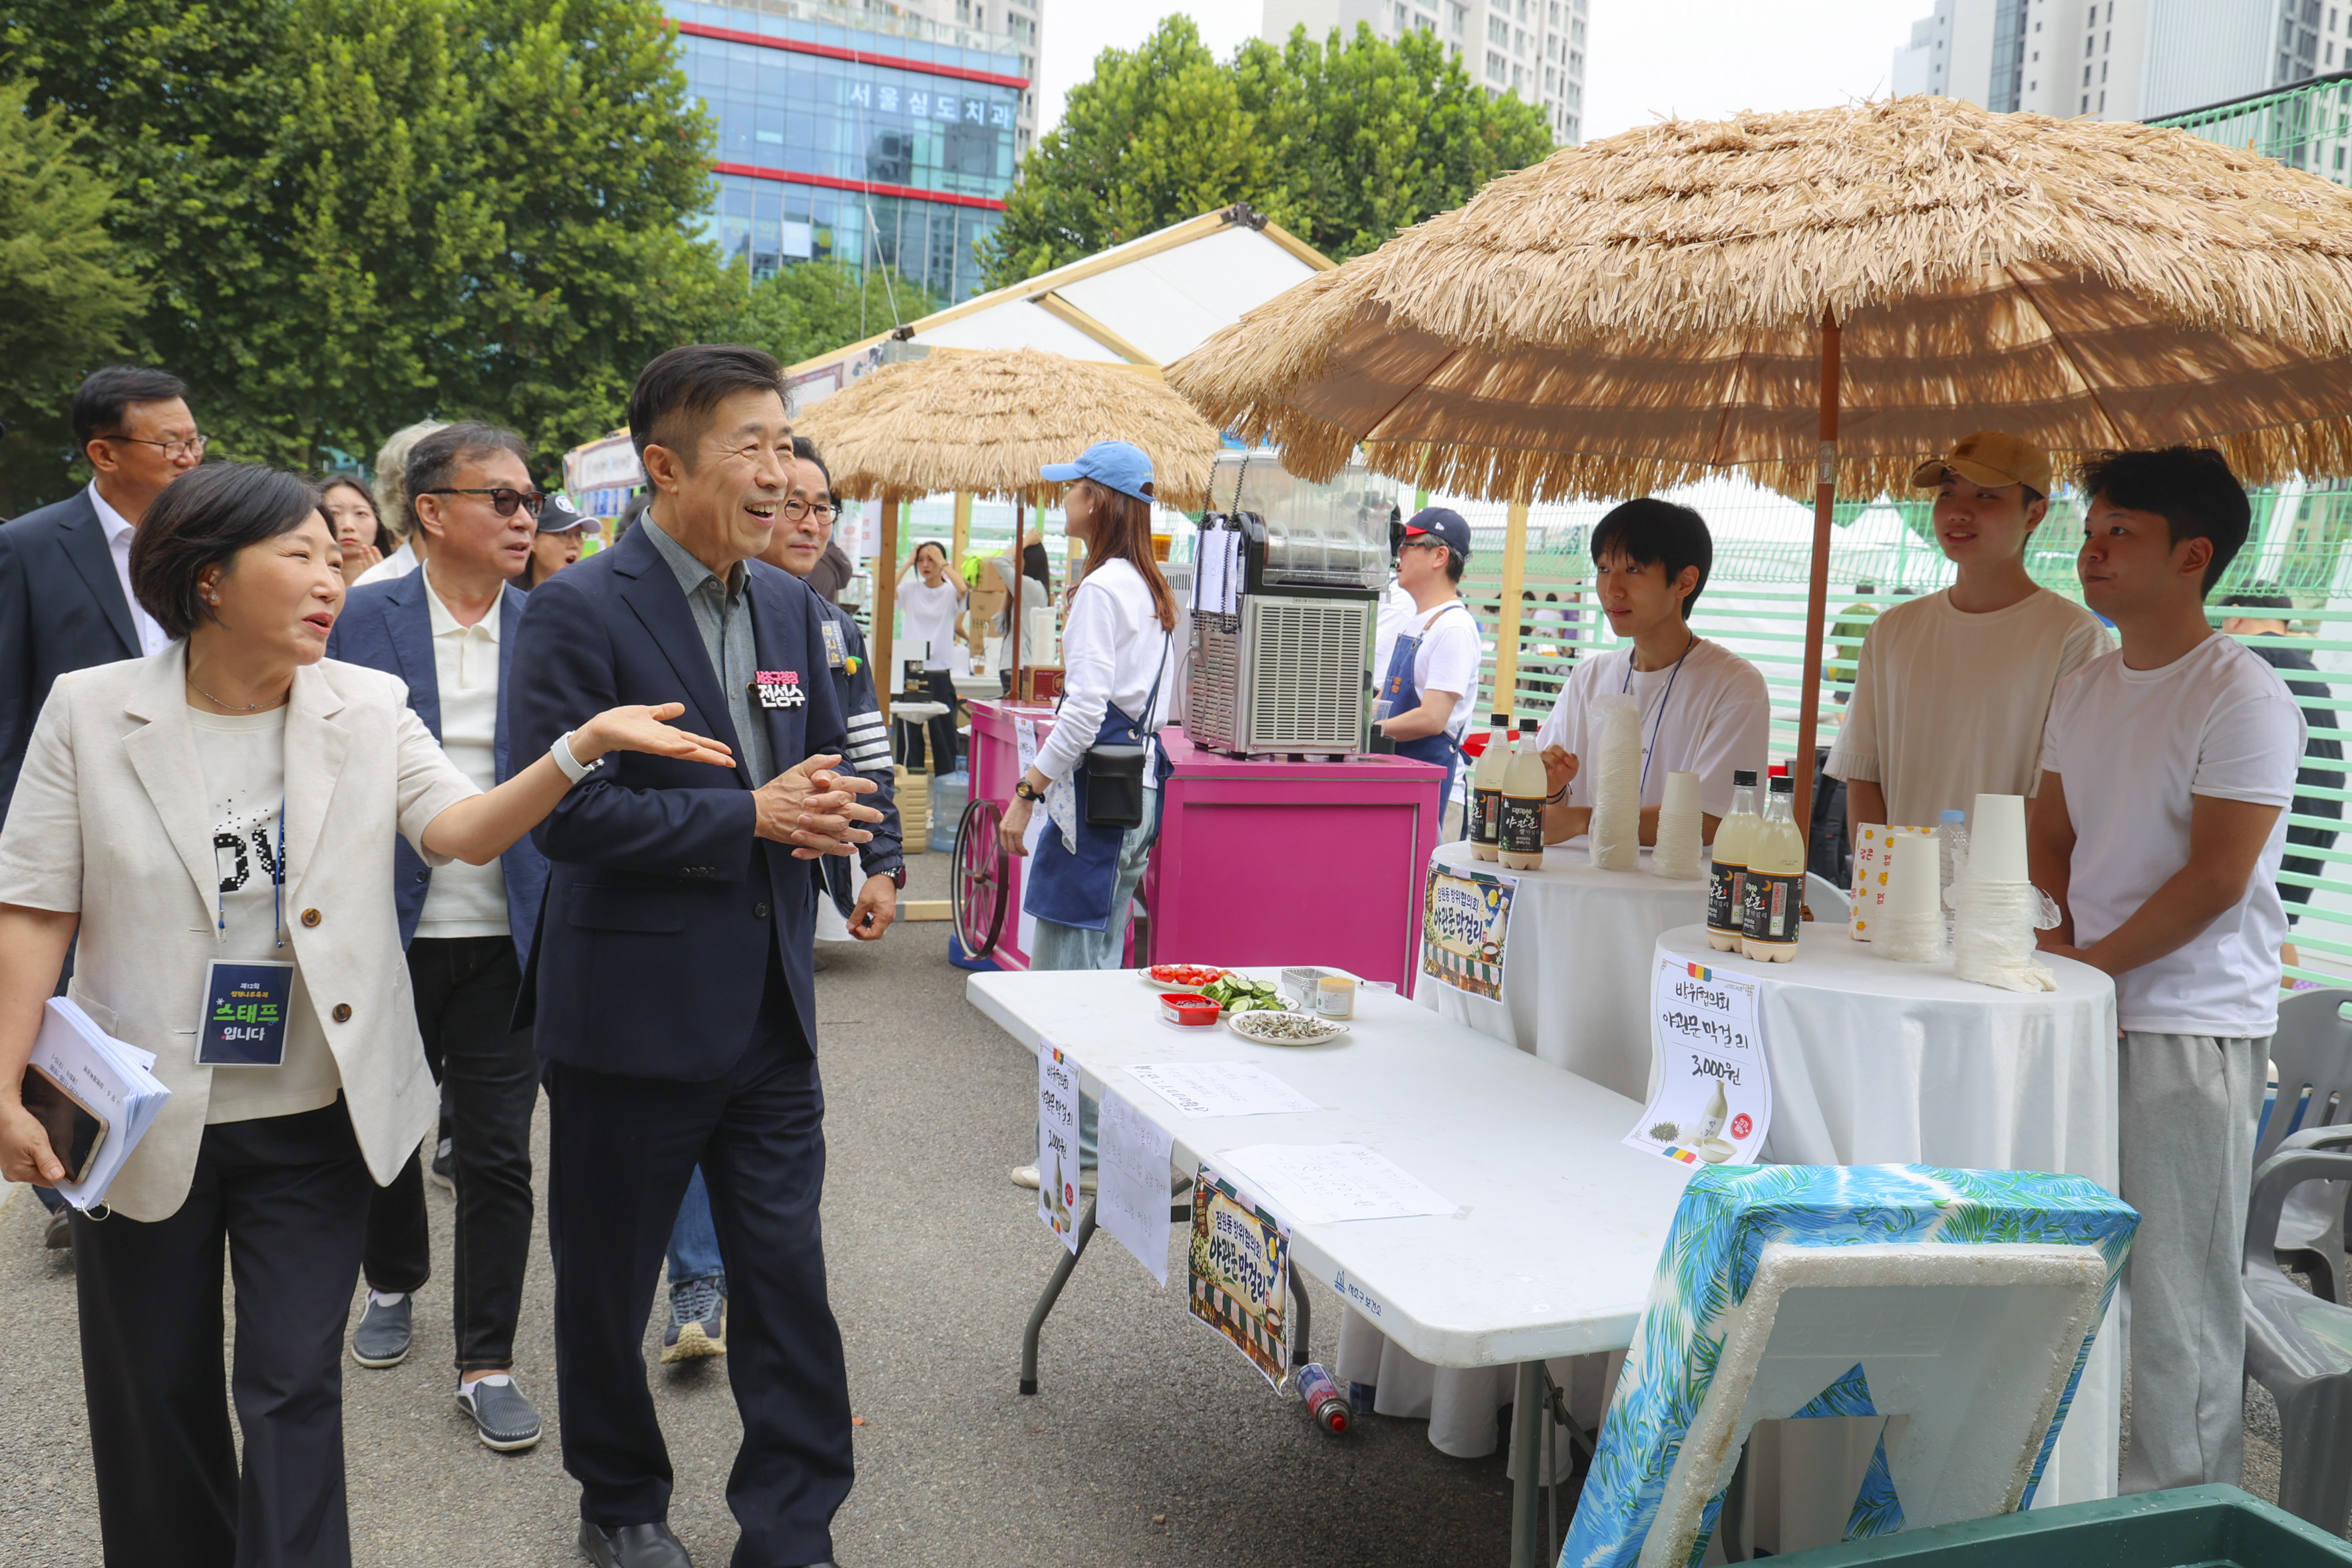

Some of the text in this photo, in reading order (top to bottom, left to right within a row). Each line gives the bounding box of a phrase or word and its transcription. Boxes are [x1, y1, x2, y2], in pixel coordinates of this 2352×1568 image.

[850, 83, 1011, 129] 서울심도치과
[755, 671, 799, 685] 서초구청장
[758, 684, 805, 707] 전성수
[1438, 887, 1479, 913] 잠원동 방위협의회
[1434, 907, 1483, 945] 야관문 막걸리
[1675, 981, 1730, 1011] 방위협의회
[213, 1003, 279, 1024] 스태프
[224, 1026, 265, 1040] 입니다
[1663, 1011, 1749, 1049] 야관문 막걸리
[1691, 1054, 1741, 1086] 3,000원
[1735, 1124, 1745, 1134] 메뉴
[1739, 1118, 1749, 1129] 인기
[1216, 1210, 1233, 1234] 잠원동
[1233, 1219, 1262, 1263] 방위협의회
[1209, 1235, 1265, 1305] 야관문 막걸리
[1348, 1283, 1364, 1303] 서초구
[1365, 1296, 1381, 1317] 보건소
